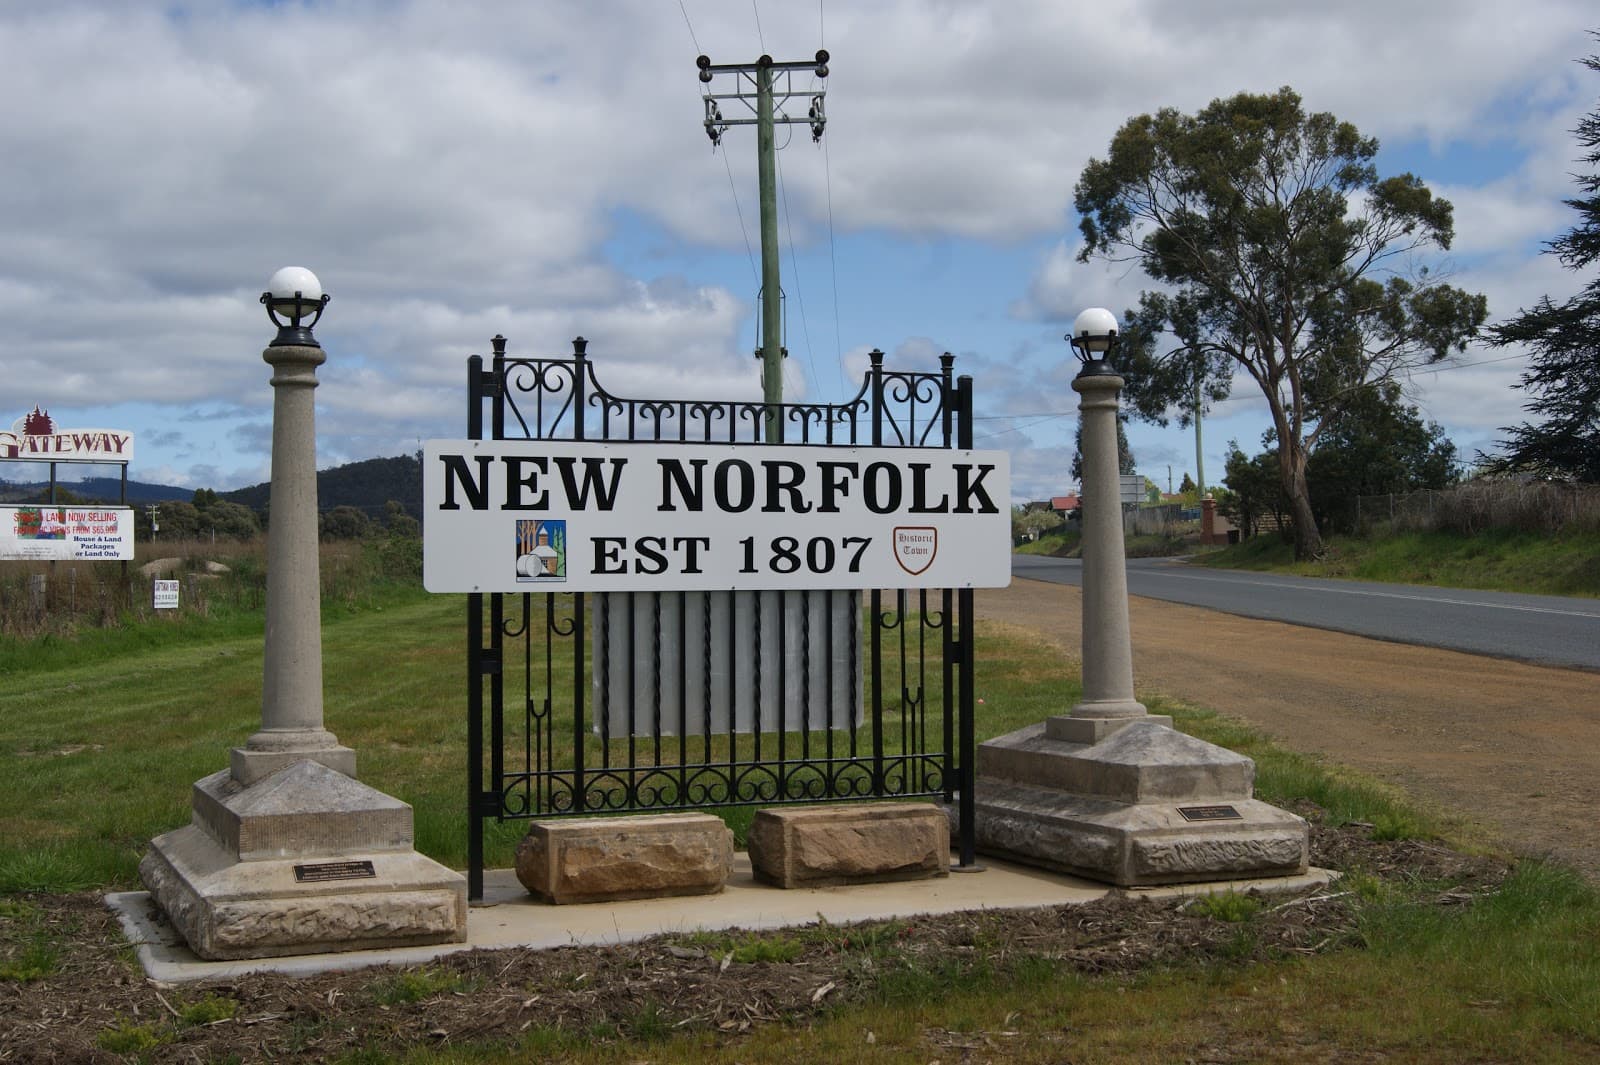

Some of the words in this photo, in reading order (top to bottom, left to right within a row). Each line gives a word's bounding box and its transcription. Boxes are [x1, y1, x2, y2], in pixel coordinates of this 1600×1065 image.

[0, 432, 129, 458] GATEWAY
[439, 454, 629, 512] NEW
[656, 458, 1000, 515] NORFOLK
[68, 512, 86, 522] NOW
[88, 512, 117, 522] SELLING
[72, 525, 91, 535] FROM
[898, 533, 933, 543] Historic
[903, 545, 928, 555] Town
[589, 536, 710, 575] EST
[738, 536, 873, 574] 1807
